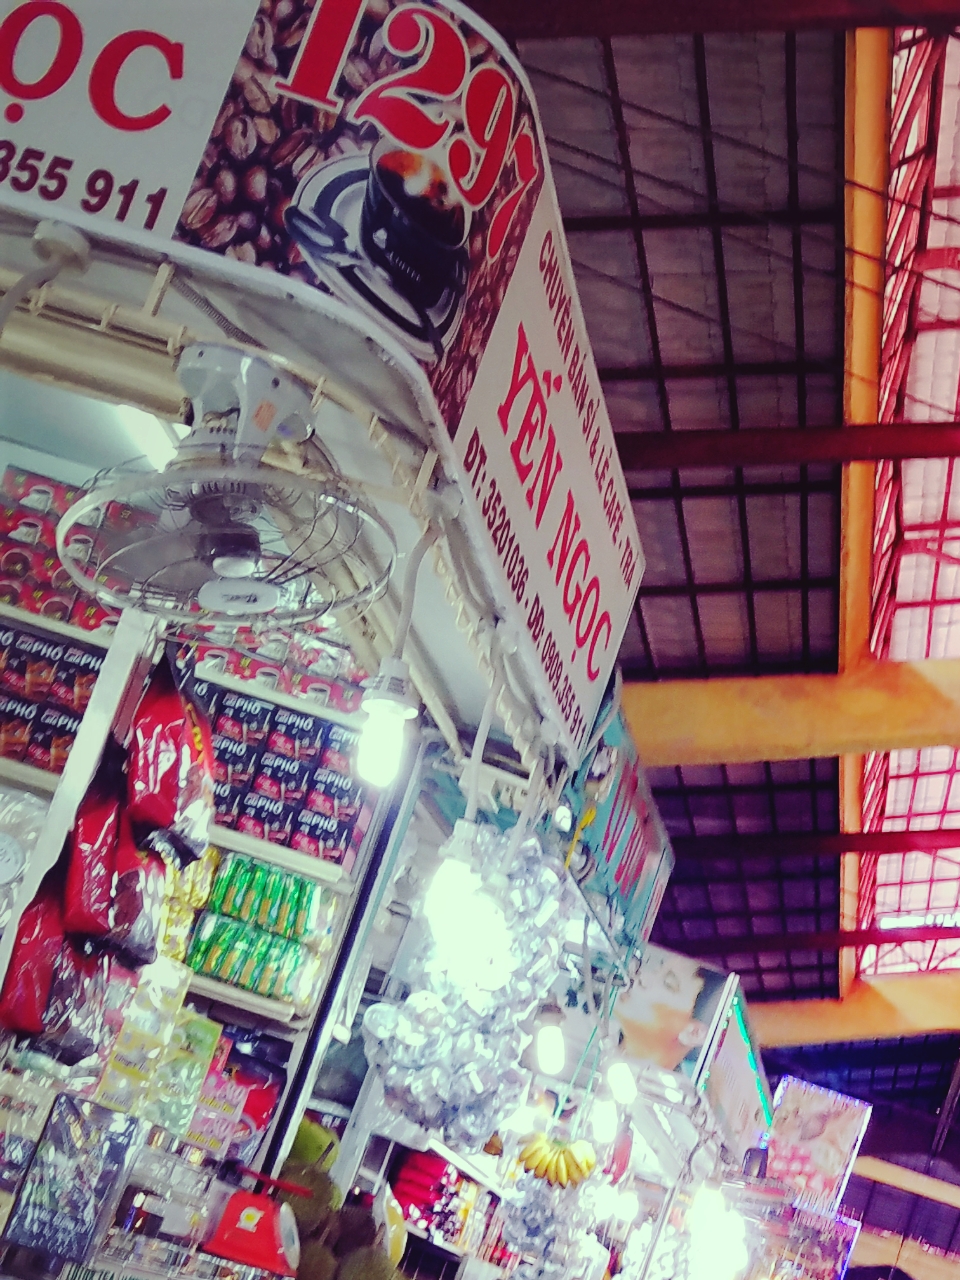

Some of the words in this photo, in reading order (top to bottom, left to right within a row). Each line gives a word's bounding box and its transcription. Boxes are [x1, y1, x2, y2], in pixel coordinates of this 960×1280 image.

[80, 168, 168, 231] 911
[497, 320, 563, 531] YẾN
[546, 488, 613, 683] NGỌC
[539, 229, 574, 365] CHUYÊN
[567, 343, 591, 418] BÁN
[589, 425, 602, 466] &
[603, 476, 627, 546] CAFÉ
[481, 477, 530, 605] 35201036
[569, 704, 588, 750] 911
